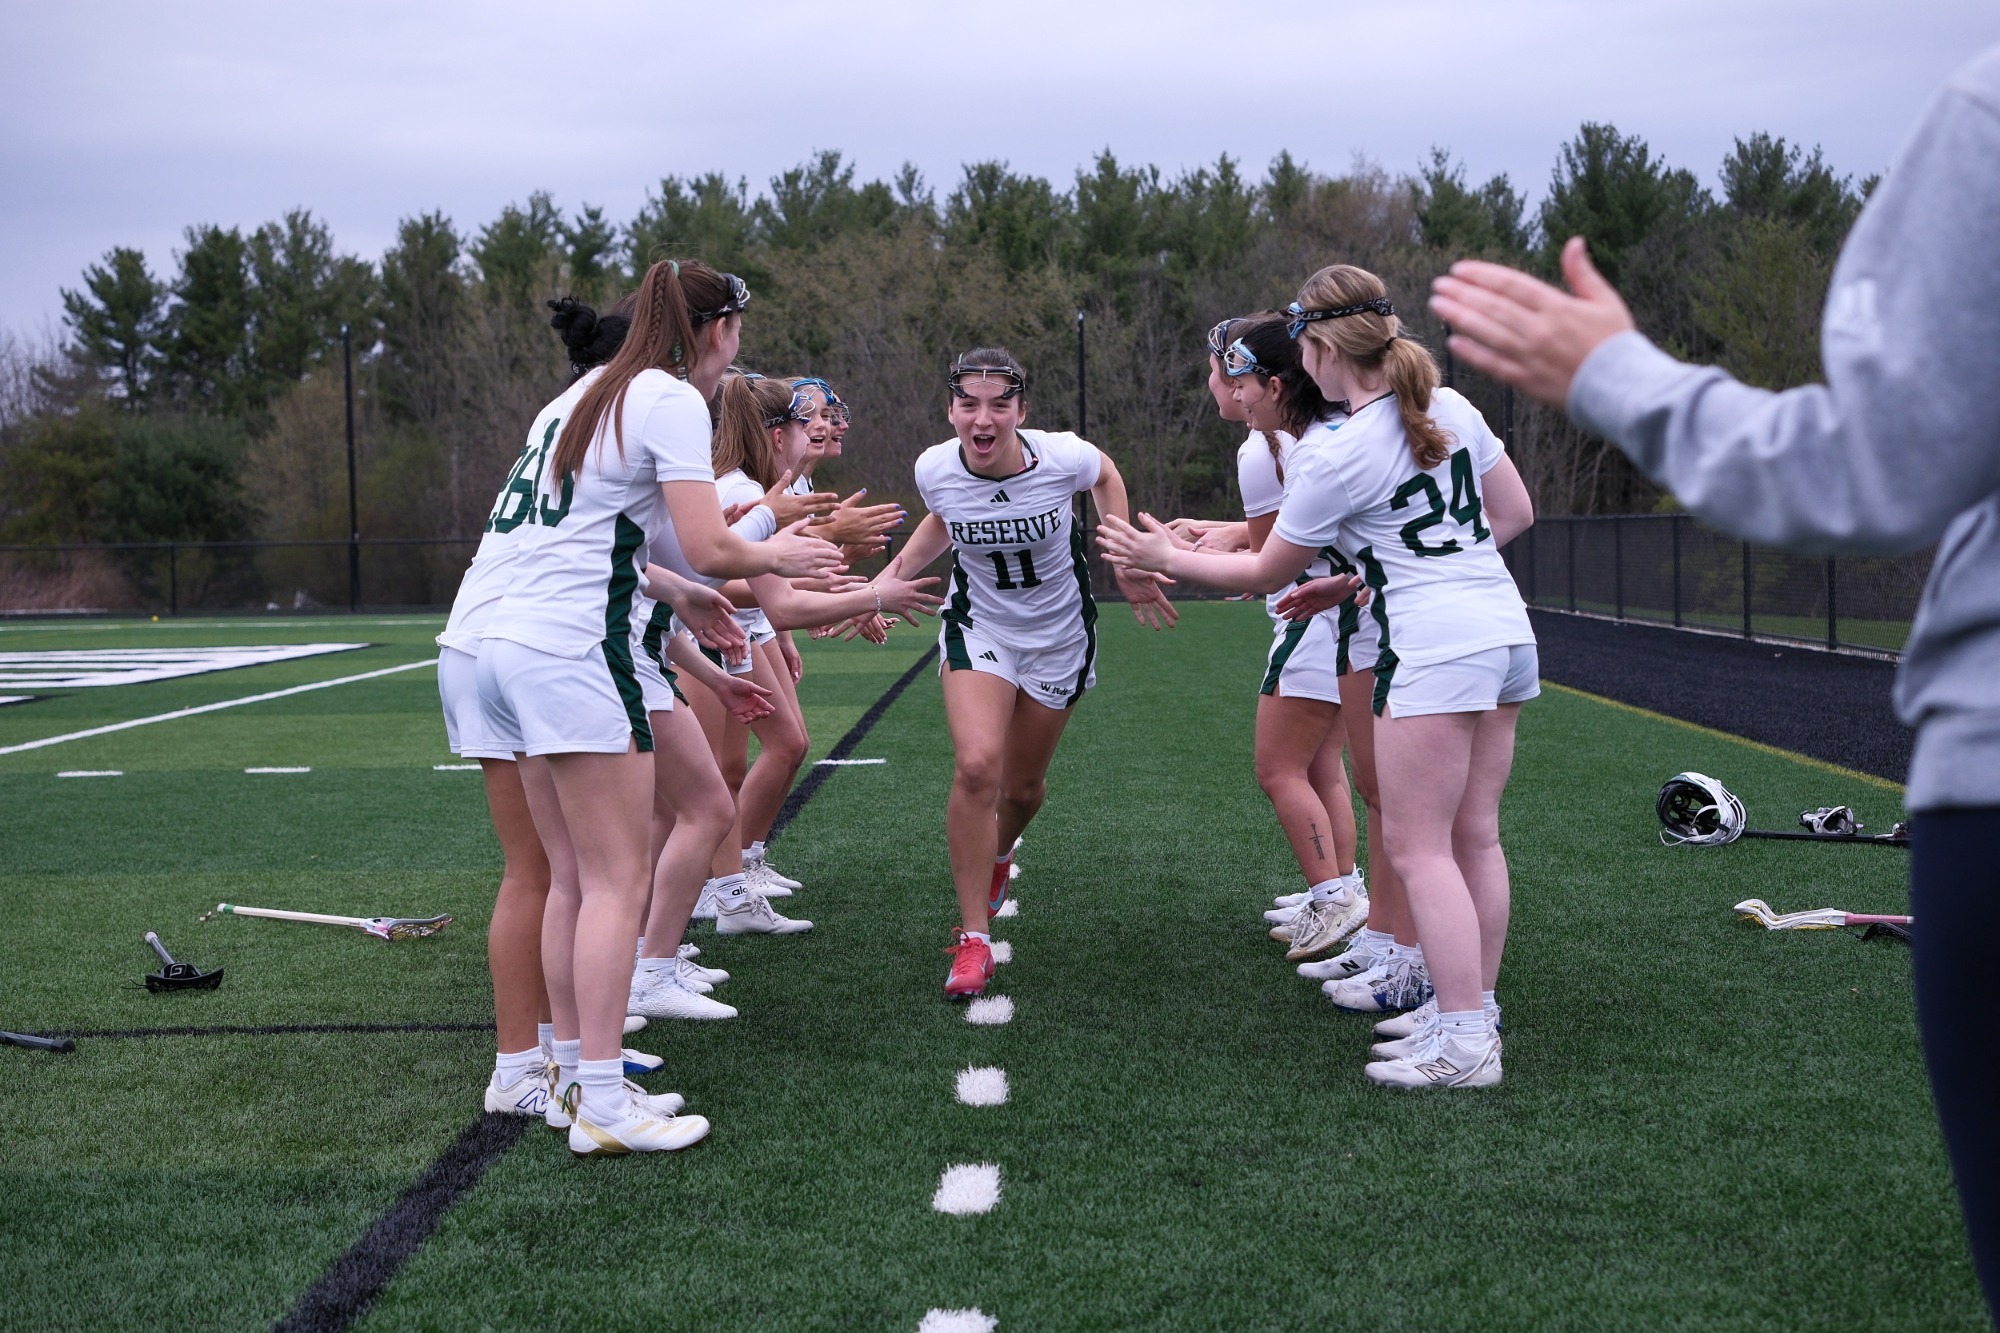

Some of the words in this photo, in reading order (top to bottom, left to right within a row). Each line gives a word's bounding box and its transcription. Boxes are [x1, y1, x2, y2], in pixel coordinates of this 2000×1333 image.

[763, 415, 785, 427] STX
[1389, 446, 1491, 557] 24
[950, 507, 1062, 545] RESERVE
[985, 548, 1042, 590] 11
